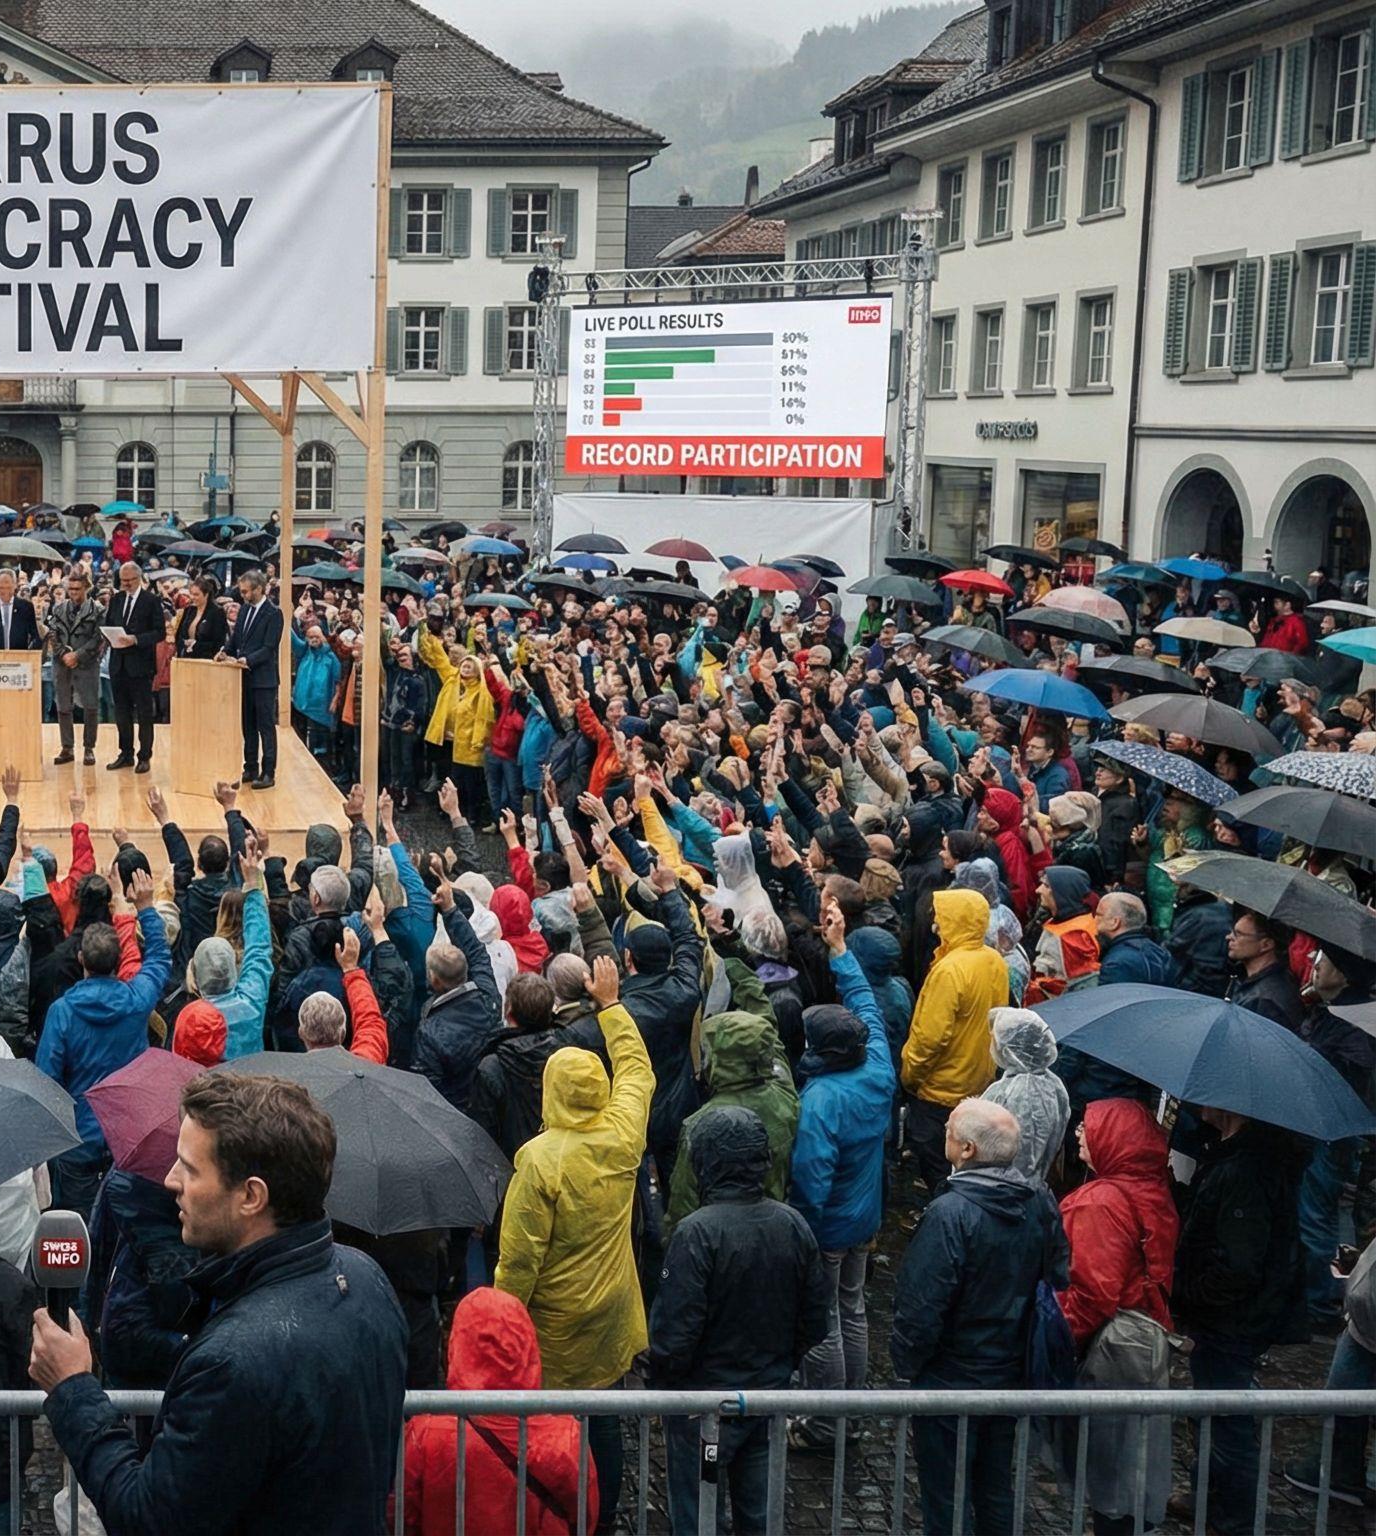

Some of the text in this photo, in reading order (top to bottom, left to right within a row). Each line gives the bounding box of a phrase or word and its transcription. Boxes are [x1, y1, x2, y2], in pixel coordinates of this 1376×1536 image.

[584, 312, 724, 332] LIVE POLL RESULTS
[785, 413, 805, 425] 0%
[581, 443, 862, 468] RECORD PARTICIPATION
[47, 1252, 80, 1265] INFO
